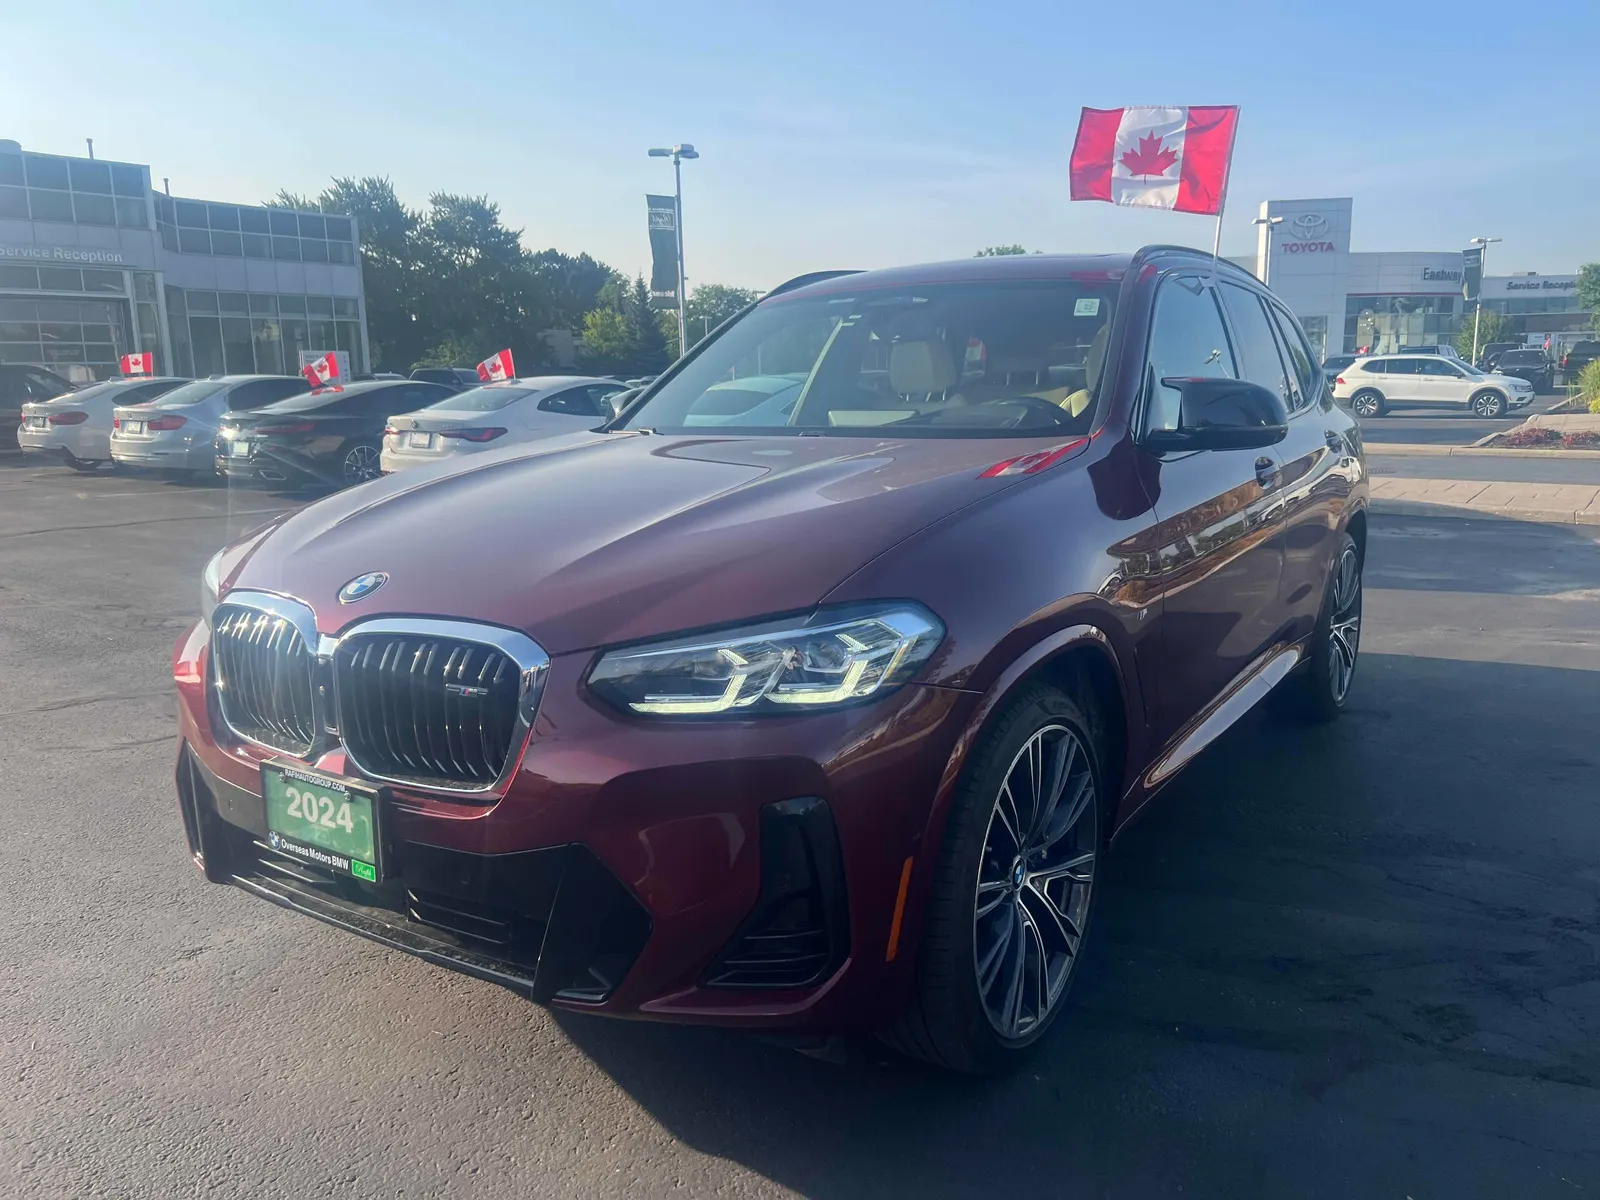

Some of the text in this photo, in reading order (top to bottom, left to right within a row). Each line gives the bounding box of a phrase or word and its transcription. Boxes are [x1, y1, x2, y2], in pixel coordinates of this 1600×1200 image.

[0, 244, 122, 263] Service Reception
[1281, 241, 1335, 253] TOYOTA
[1423, 267, 1462, 284] Eastway
[1506, 279, 1576, 291] Service Recepti
[284, 769, 346, 792] RAFIHAUTOGROUP.COM
[285, 786, 354, 834] 2024
[281, 838, 310, 857] Overseas
[309, 848, 332, 864] Motors
[331, 856, 349, 870] BMW
